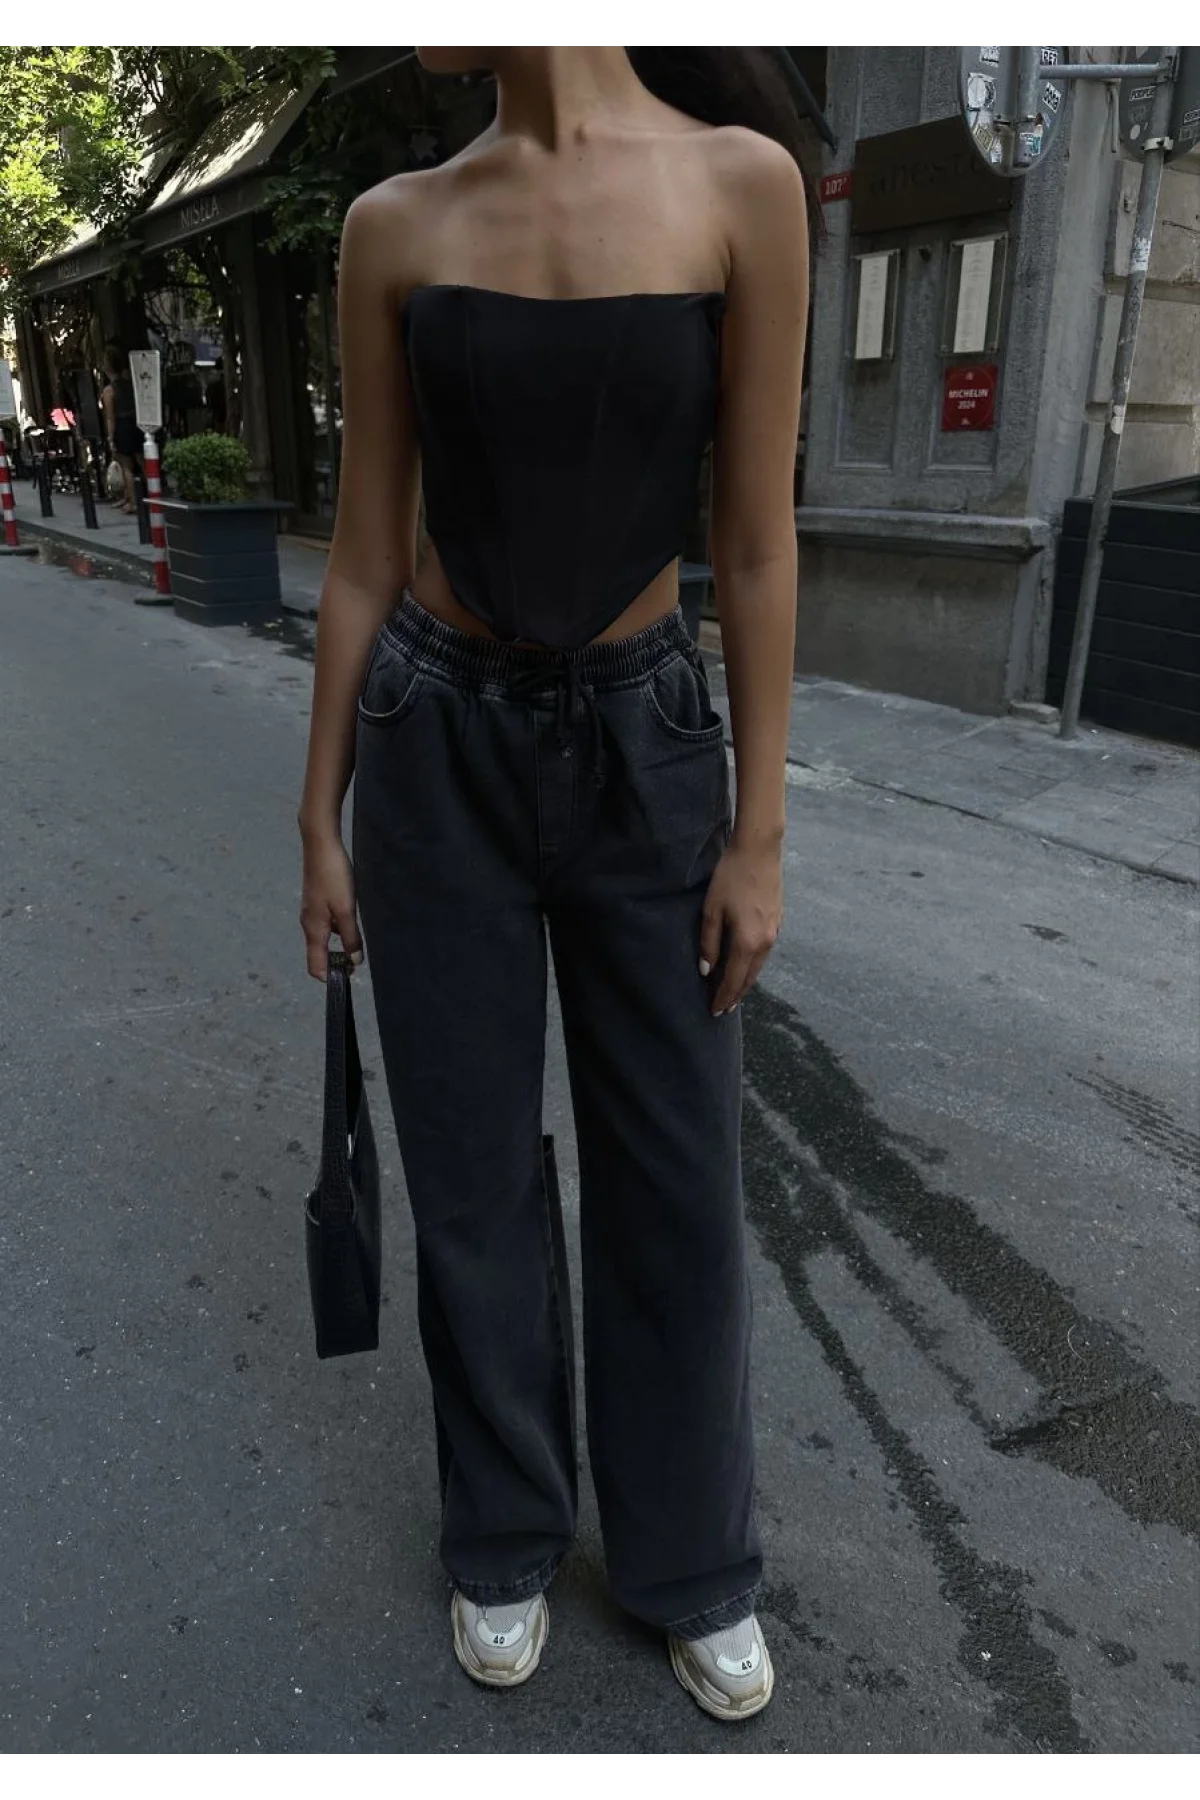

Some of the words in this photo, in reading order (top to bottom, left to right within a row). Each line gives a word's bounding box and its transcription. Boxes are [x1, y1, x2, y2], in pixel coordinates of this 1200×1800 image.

[180, 195, 220, 229] MISELA
[948, 388, 989, 398] MICHELIN
[957, 400, 975, 410] 2024
[493, 1634, 505, 1644] 40
[741, 1660, 753, 1670] 40
